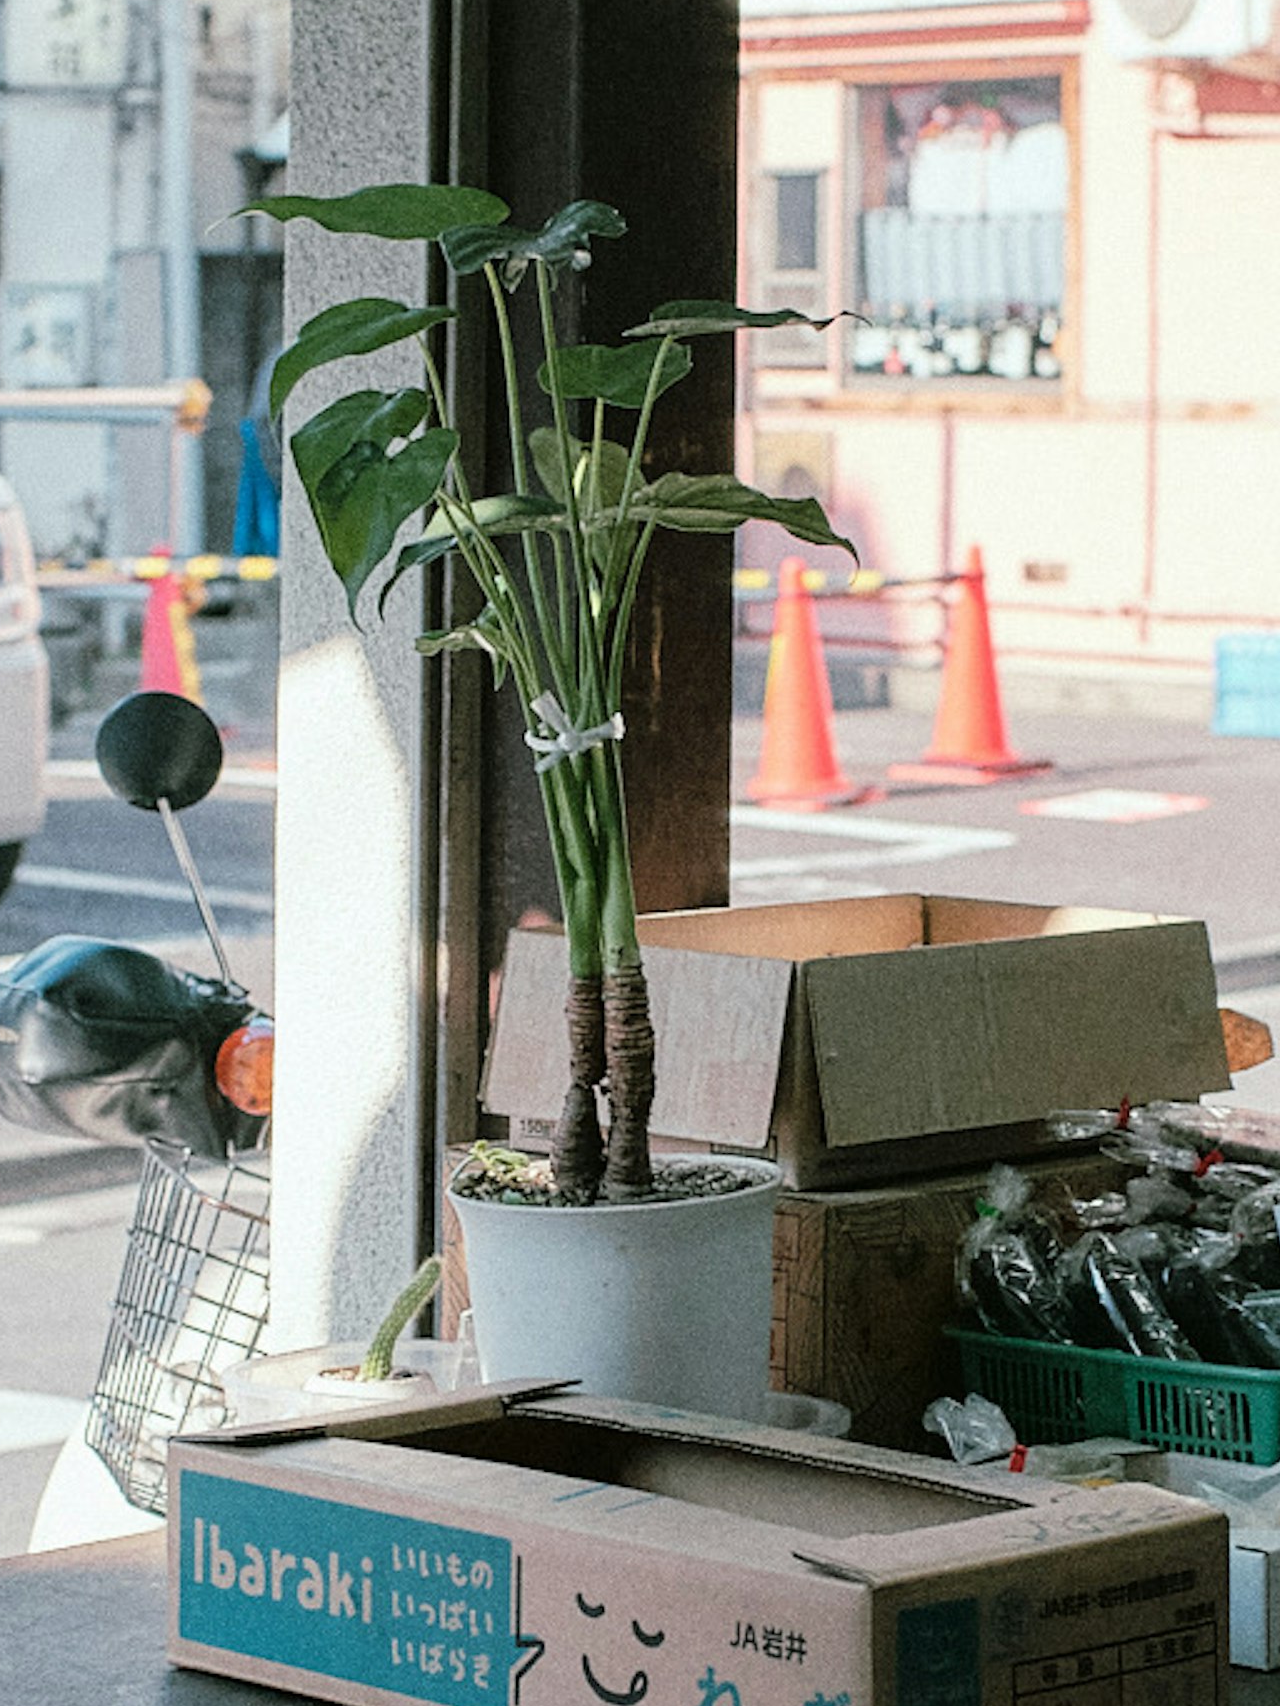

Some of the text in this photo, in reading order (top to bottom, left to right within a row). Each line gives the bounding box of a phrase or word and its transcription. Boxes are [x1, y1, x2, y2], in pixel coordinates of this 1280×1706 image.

[194, 1517, 372, 1624] Ibaraki
[391, 1543, 494, 1590] いいもの
[391, 1590, 494, 1637] いっぱい
[391, 1638, 492, 1689] いばらき
[730, 1621, 808, 1665] JA岩井
